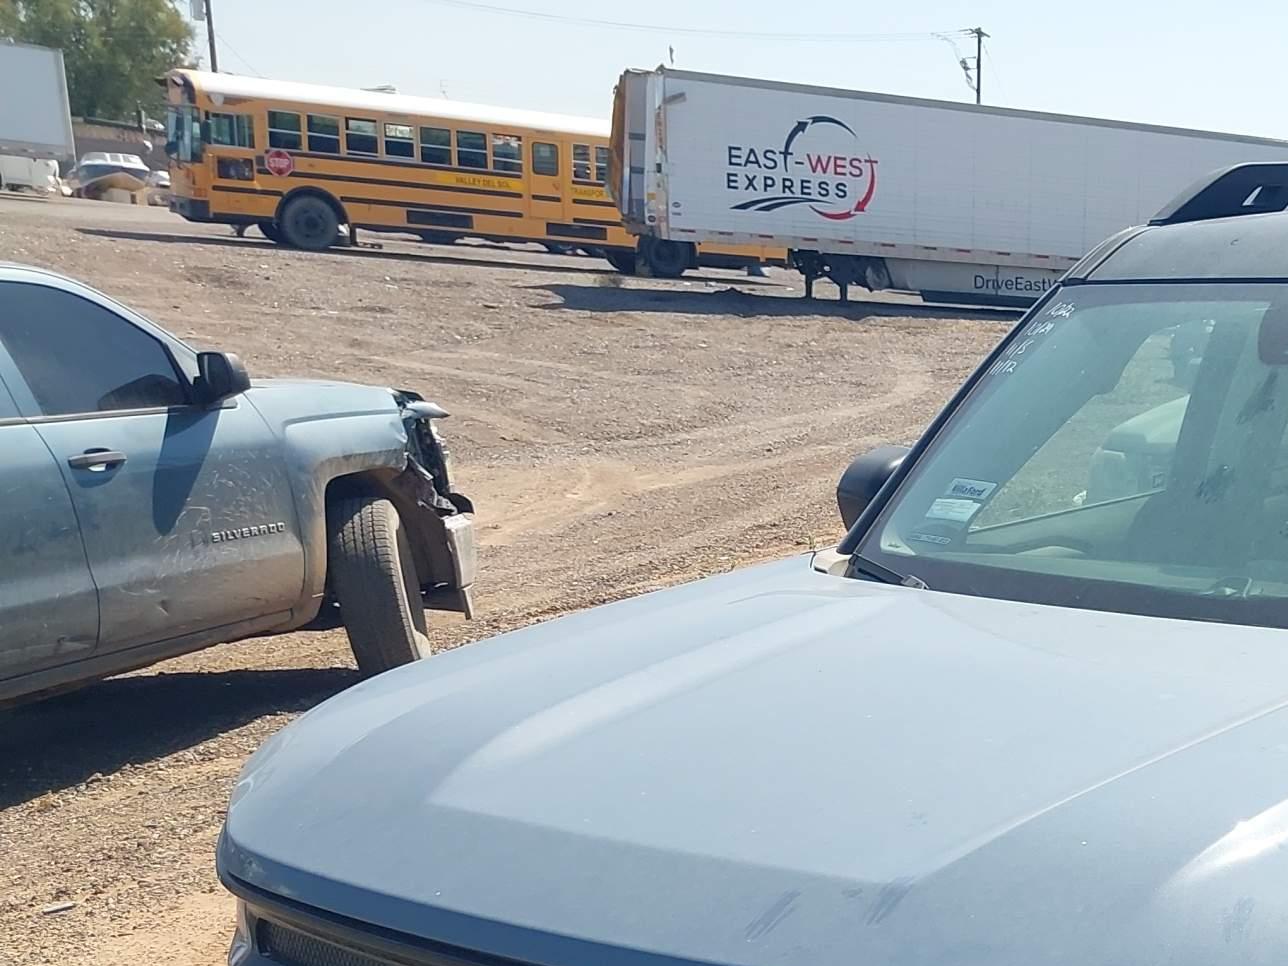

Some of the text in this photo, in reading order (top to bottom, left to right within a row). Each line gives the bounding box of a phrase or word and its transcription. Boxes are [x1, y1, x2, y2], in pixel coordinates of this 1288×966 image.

[269, 157, 290, 168] STOP
[728, 145, 878, 178] EAST-WEST
[727, 172, 848, 198] EXPRESS
[211, 522, 286, 543] SILVERADO
